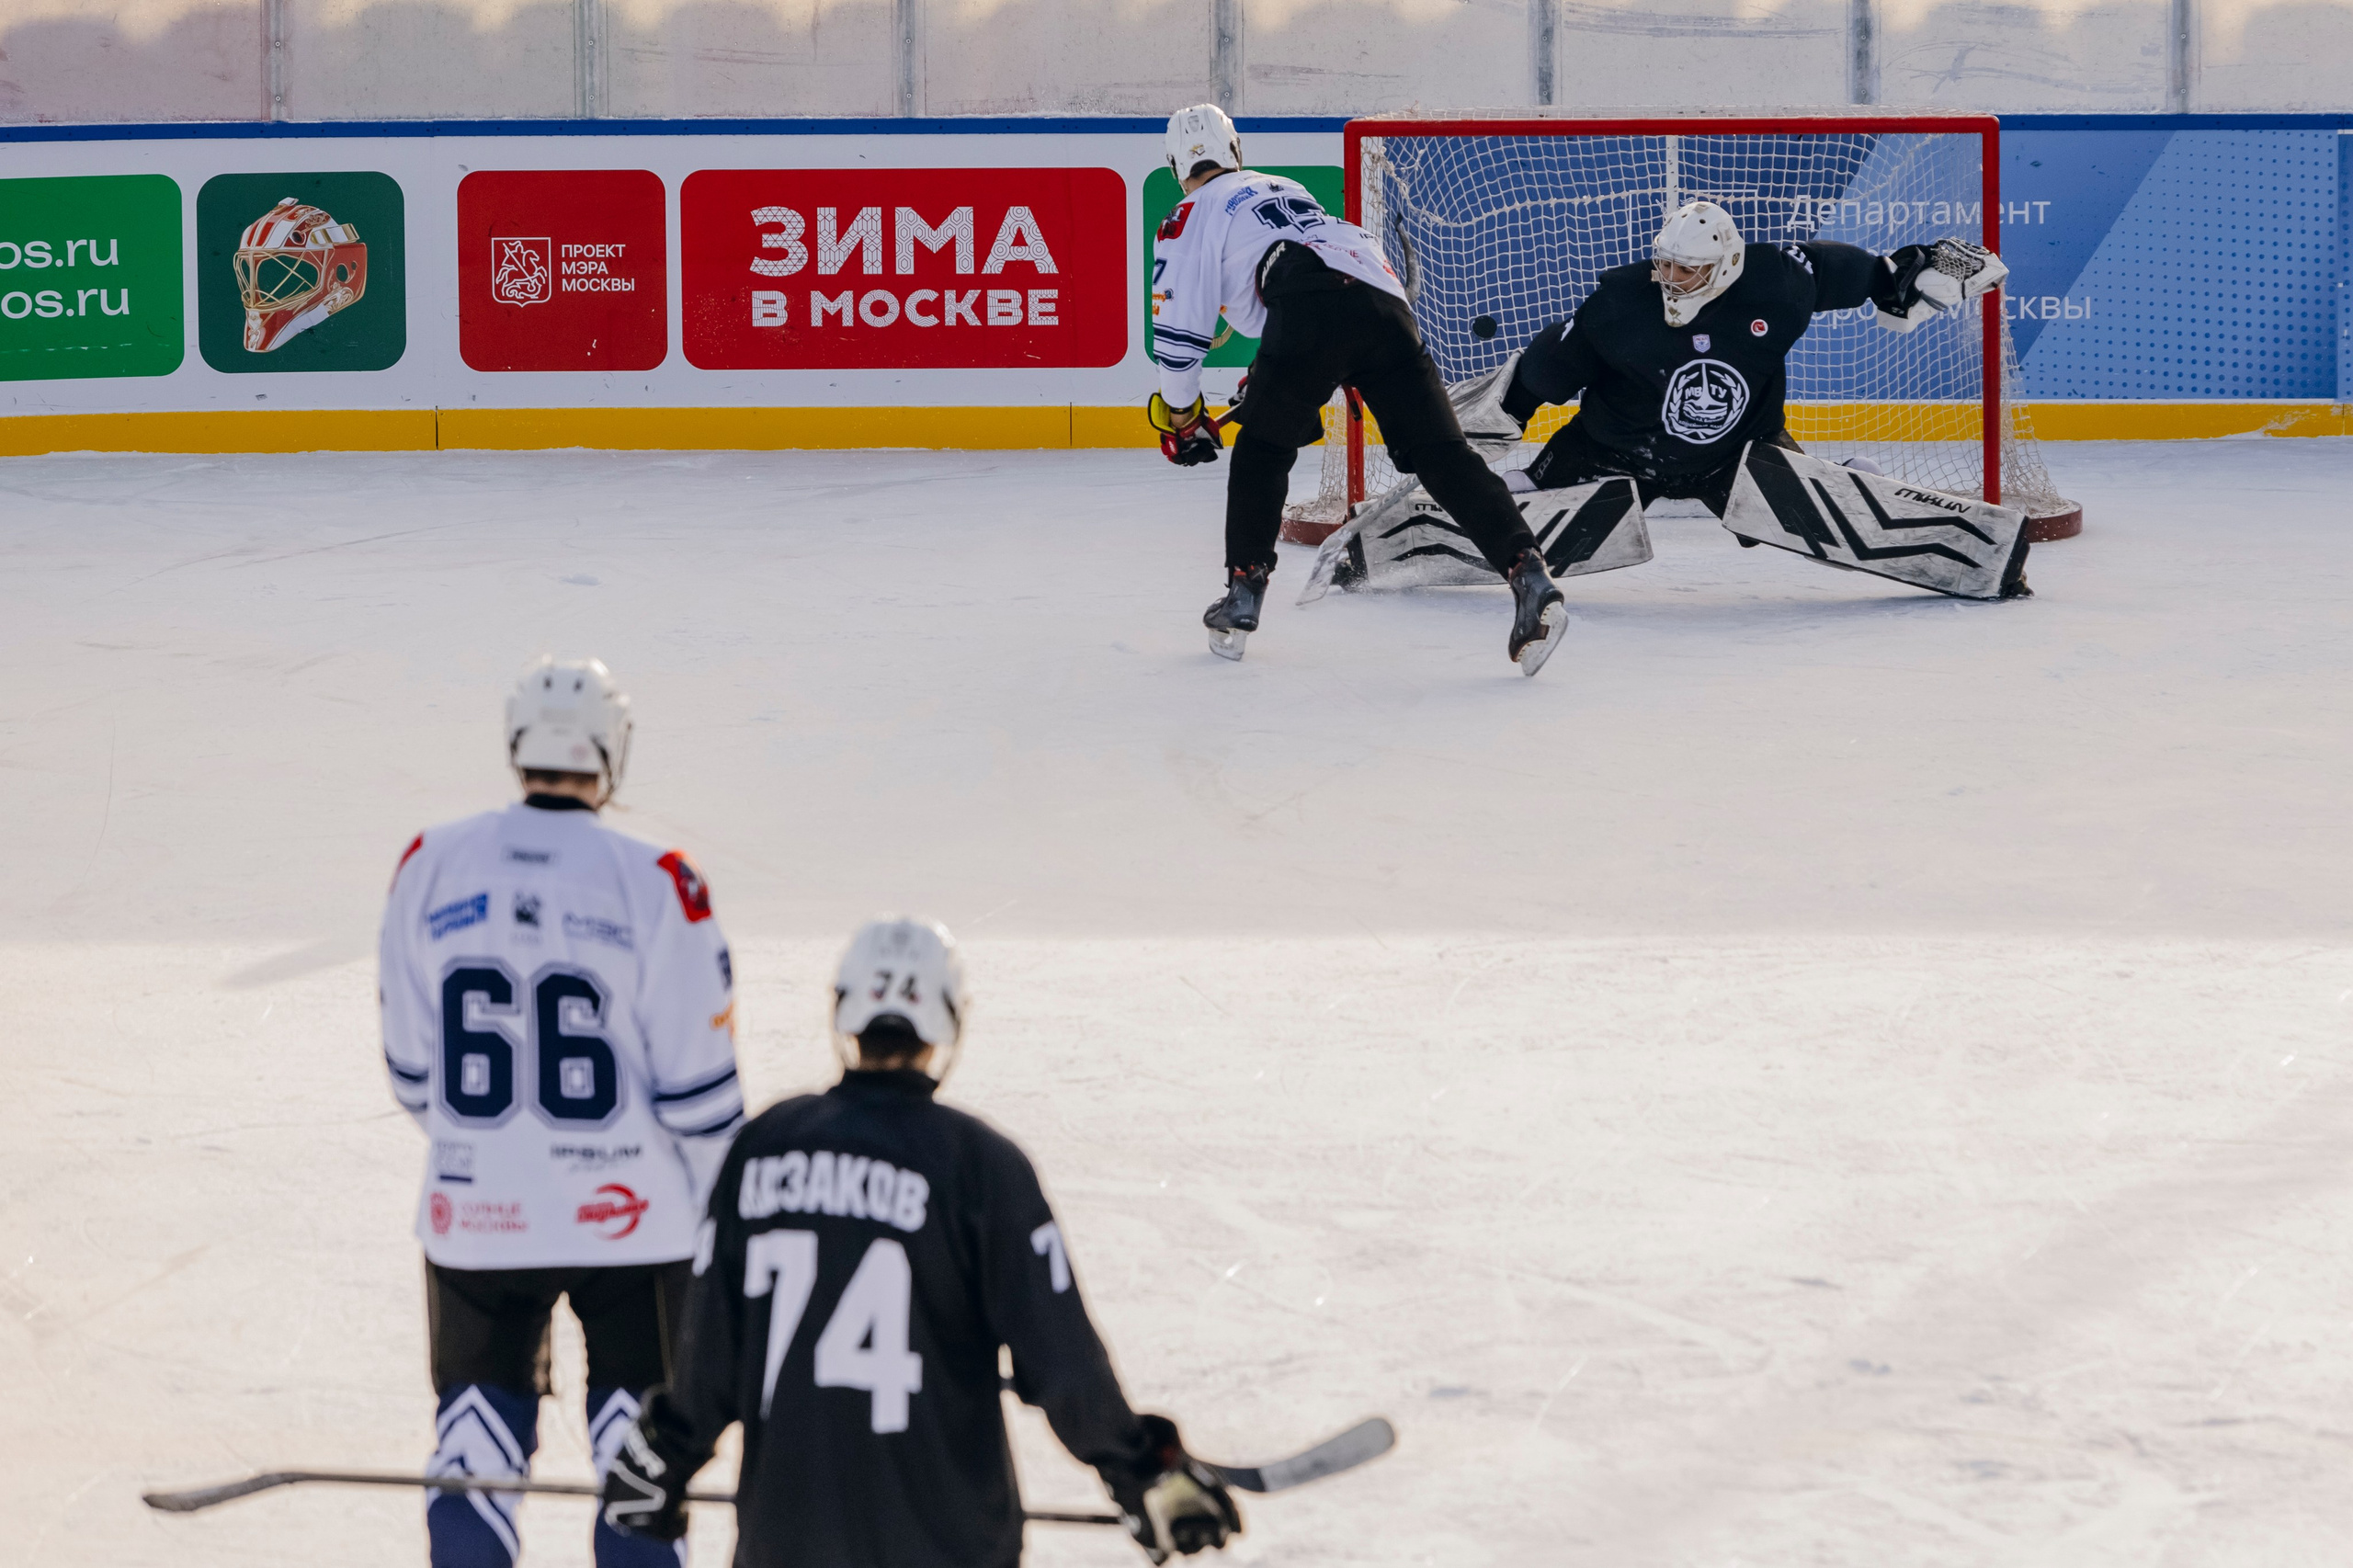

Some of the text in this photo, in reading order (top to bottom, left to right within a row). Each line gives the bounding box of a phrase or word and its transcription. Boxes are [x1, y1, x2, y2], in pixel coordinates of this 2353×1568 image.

[561, 244, 627, 258] ПРОЕКТ
[749, 205, 1059, 277] ЗИМА
[562, 260, 609, 275] МЭРА
[562, 278, 636, 292] МОСКВЫ
[751, 288, 1060, 328] В МОСКВЕ
[437, 956, 631, 1131] 66
[743, 1228, 924, 1435] 74
